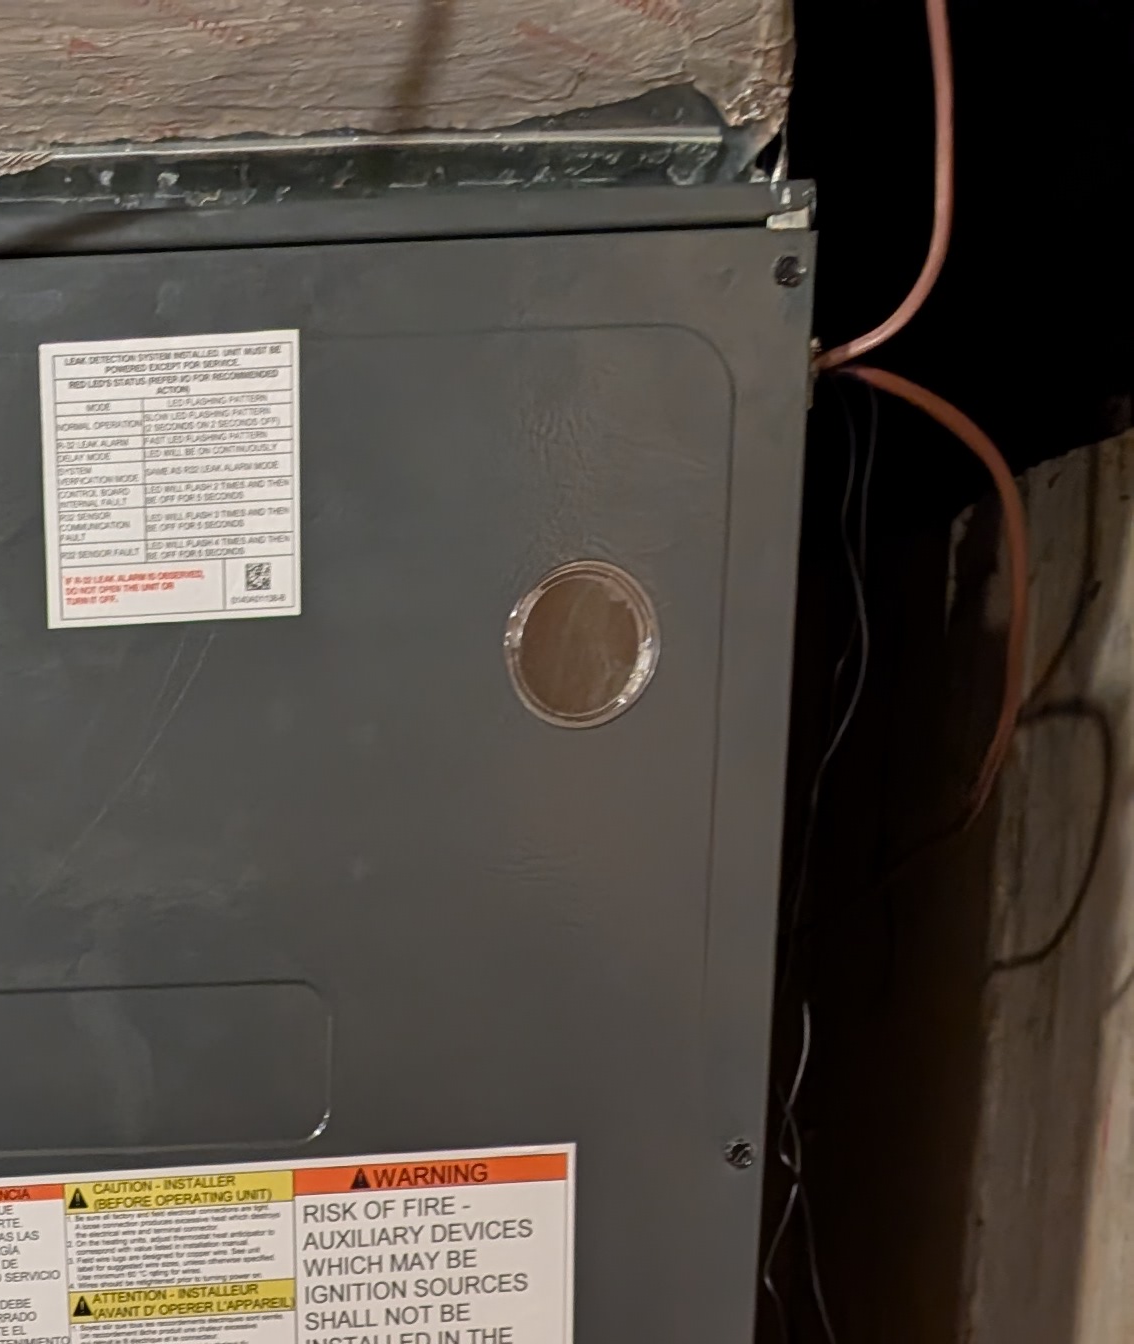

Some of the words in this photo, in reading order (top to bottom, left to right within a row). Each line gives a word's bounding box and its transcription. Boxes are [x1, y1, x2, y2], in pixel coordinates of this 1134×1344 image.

[92, 1180, 152, 1194] CAUTION
[163, 1176, 236, 1190] INSTALLER
[373, 1164, 488, 1188] WARNING
[93, 1196, 151, 1210] (BEFORE
[154, 1192, 233, 1206] OPERATING
[236, 1189, 272, 1202] UNIT)
[303, 1202, 357, 1223] RISK
[363, 1200, 396, 1219] OF
[402, 1197, 455, 1217] FIRE
[301, 1226, 425, 1250] AUXILIARY
[430, 1219, 533, 1243] DEVICES
[303, 1255, 383, 1277] WHICH
[389, 1252, 440, 1272] MAY
[446, 1249, 477, 1269] BE
[91, 1289, 166, 1304] ATTENTION
[177, 1284, 258, 1299] INSTALLEUR
[304, 1280, 407, 1303] IGNITION
[413, 1273, 528, 1297] SOURCES
[304, 1309, 378, 1330] SHALL
[384, 1306, 434, 1326] NOT
[439, 1303, 470, 1323] BE
